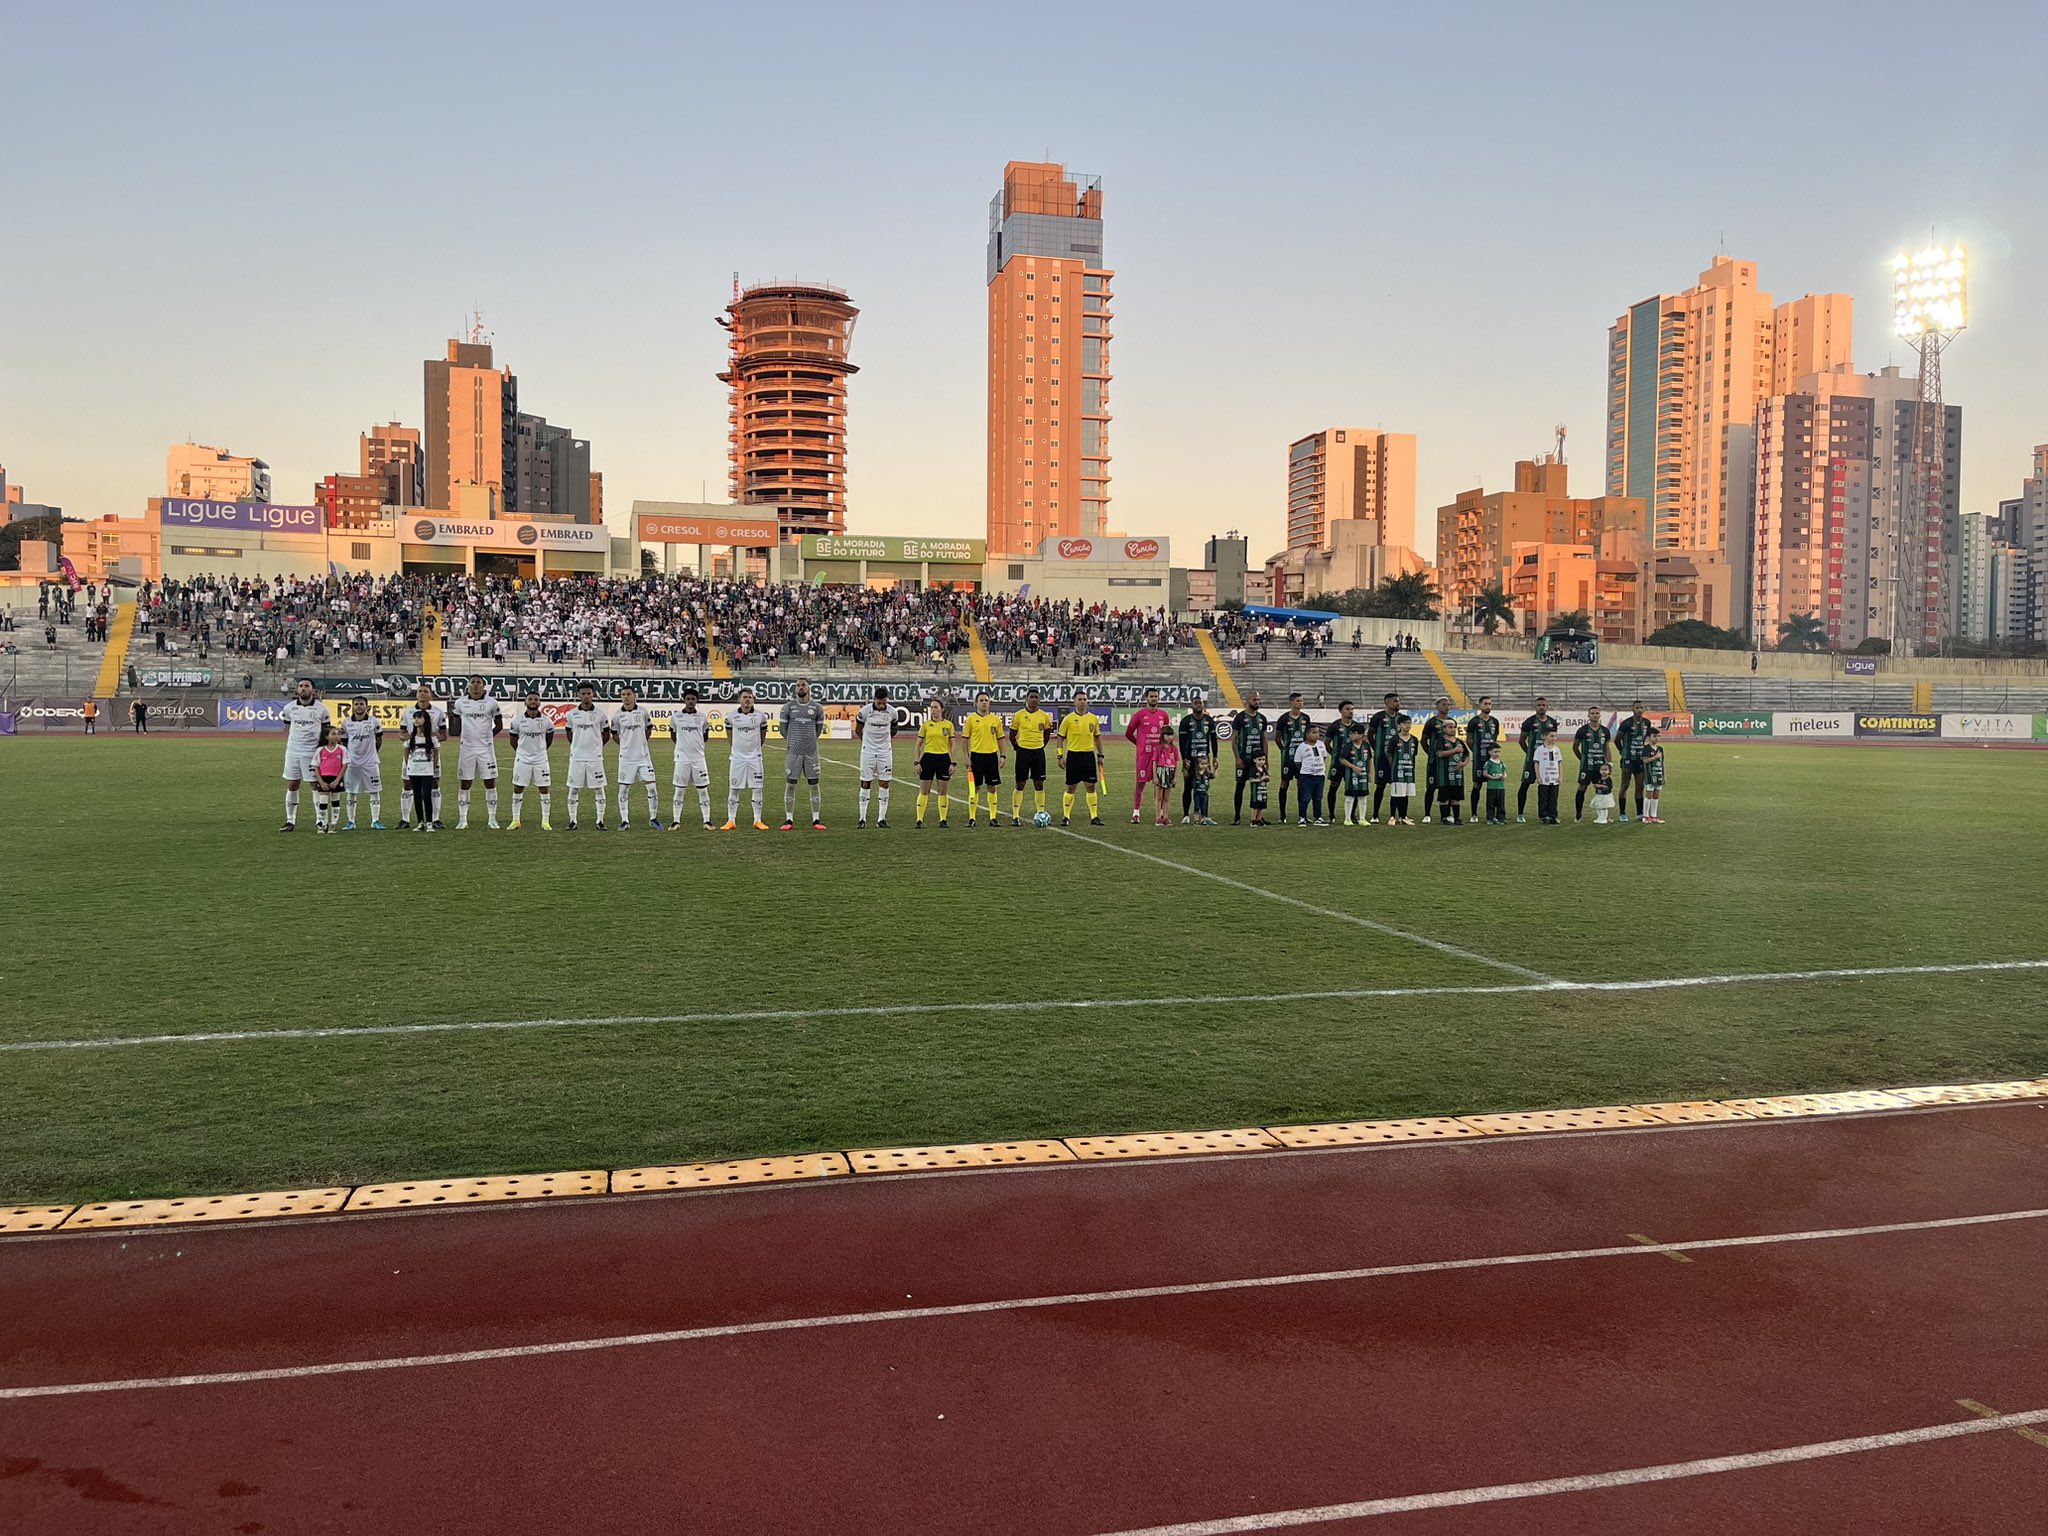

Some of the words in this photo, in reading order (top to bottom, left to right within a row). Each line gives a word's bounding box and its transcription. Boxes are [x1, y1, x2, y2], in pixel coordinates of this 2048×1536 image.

[168, 501, 237, 523] Ligue
[249, 507, 316, 528] Ligue
[438, 524, 494, 536] EMBRAED
[540, 529, 594, 540] EMBRAED
[660, 525, 702, 536] CRESOL
[730, 528, 771, 538] CRESOL
[843, 540, 886, 548] MORADIA
[929, 542, 972, 551] MORADIA
[1061, 542, 1091, 557] Canção
[1127, 542, 1158, 558] Canção
[849, 549, 886, 557] FUTURO
[936, 551, 971, 560] FUTURO
[1846, 662, 1875, 672] Ligue
[416, 676, 510, 699] FORA
[754, 681, 824, 702] SOMS
[1015, 684, 1057, 703] CM
[1114, 685, 1127, 703] E
[1699, 718, 1767, 730] polpanorte
[1790, 719, 1840, 732] meleus
[1859, 717, 1937, 729] COMTINTAS
[1974, 719, 2014, 728] VITA
